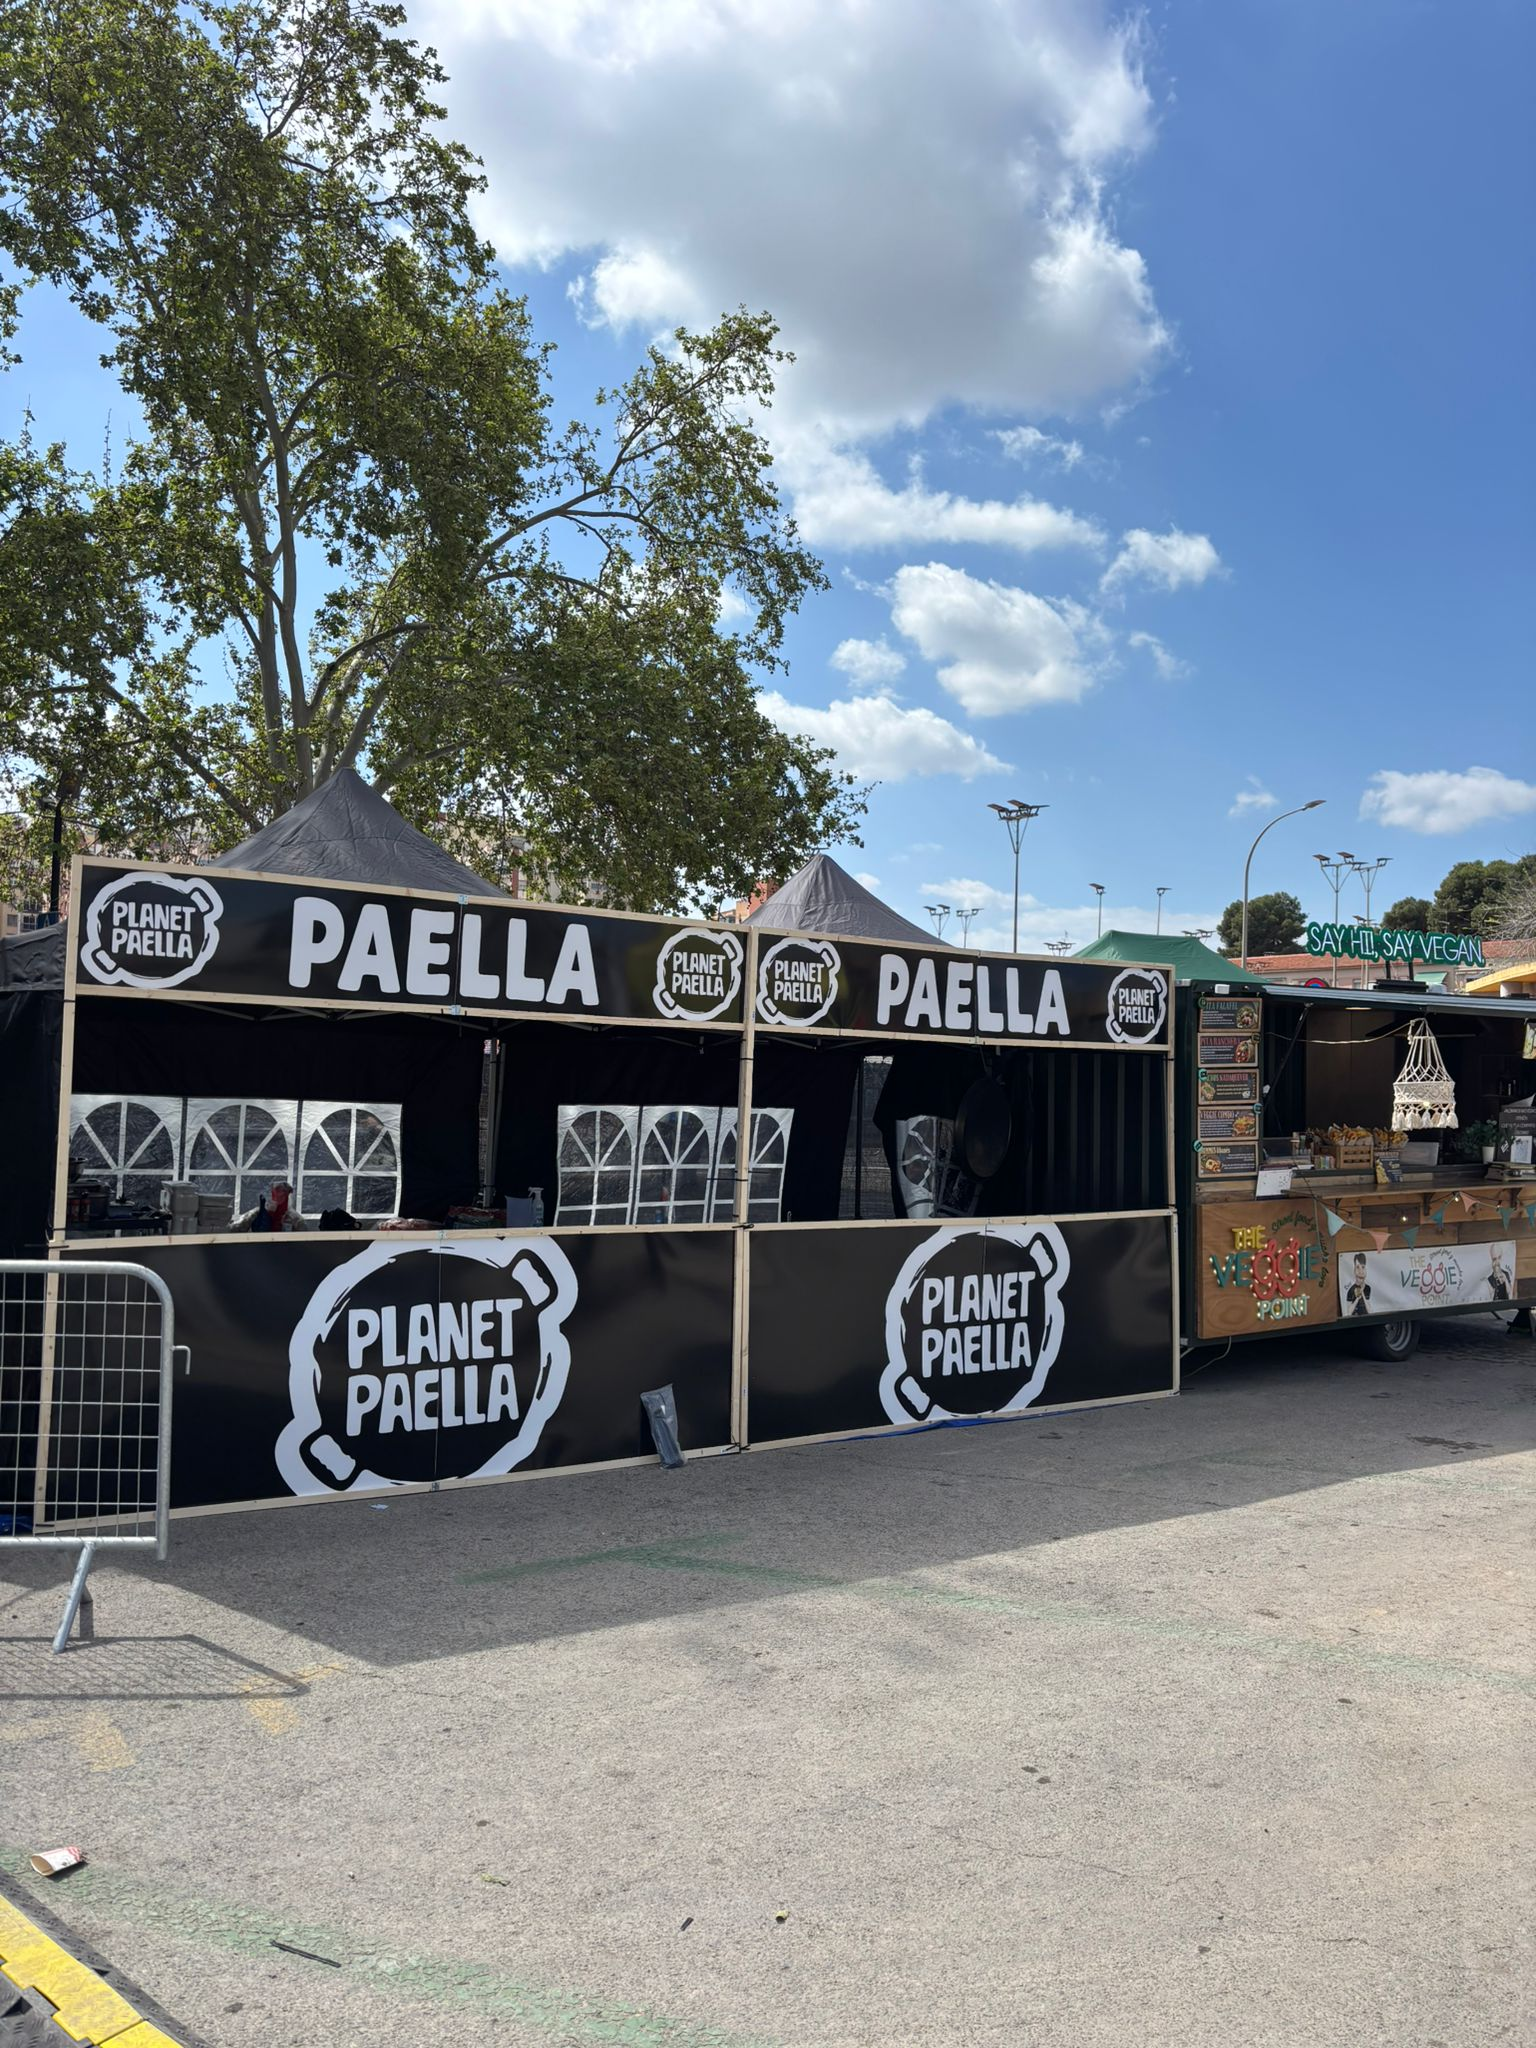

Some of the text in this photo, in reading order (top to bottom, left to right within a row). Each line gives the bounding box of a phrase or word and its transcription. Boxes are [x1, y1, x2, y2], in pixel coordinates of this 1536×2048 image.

[113, 902, 196, 932] PLANET
[112, 928, 194, 959] PAELLA
[289, 897, 600, 1006] PAELLA
[1310, 926, 1345, 953] SAY
[1383, 932, 1416, 958] SAY
[672, 950, 726, 975] PLANET
[774, 960, 825, 983] PLANET
[671, 972, 725, 997] PAELLA
[774, 980, 823, 1004] PAELLA
[877, 954, 1071, 1035] PAELLA
[1119, 988, 1156, 1007] PLANET
[1118, 1004, 1155, 1024] PAELLA
[1232, 1225, 1266, 1249] THE
[1409, 1255, 1426, 1268] THE
[923, 1272, 1036, 1325] PLANET
[1257, 1294, 1310, 1321] POINT
[1422, 1294, 1451, 1307] POINT
[348, 1299, 523, 1370] PLANET
[922, 1323, 1032, 1378] PAELLA
[347, 1364, 519, 1437] PAELLA
